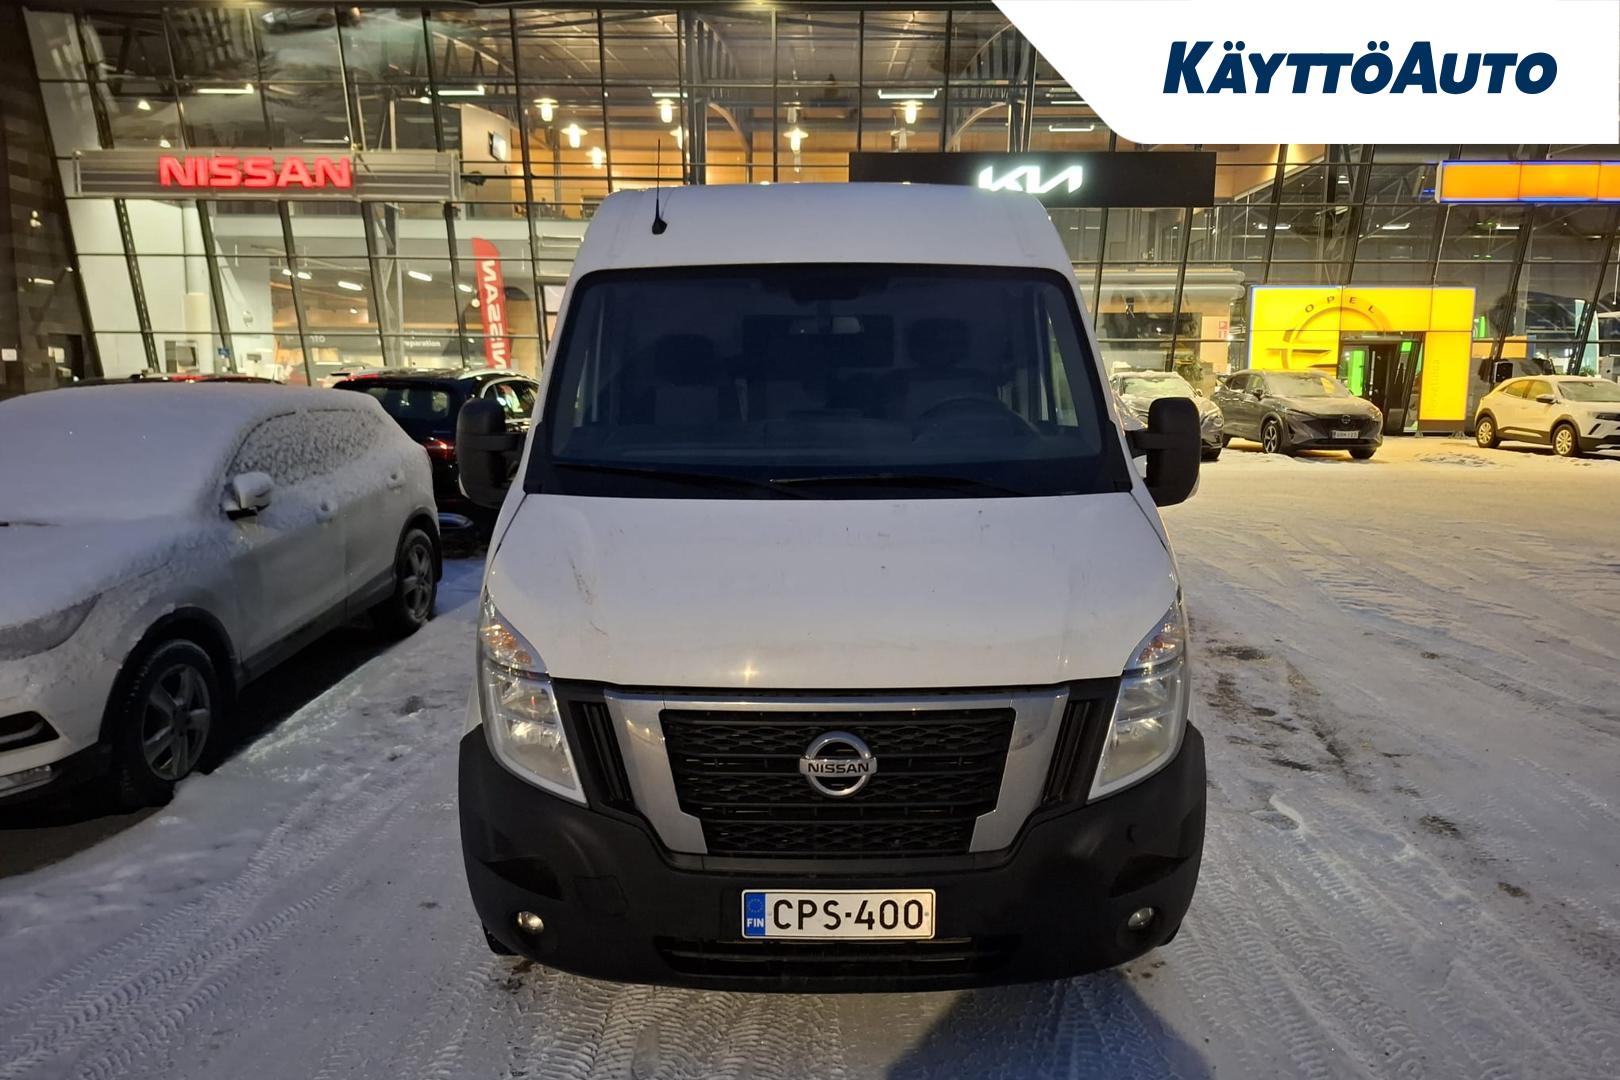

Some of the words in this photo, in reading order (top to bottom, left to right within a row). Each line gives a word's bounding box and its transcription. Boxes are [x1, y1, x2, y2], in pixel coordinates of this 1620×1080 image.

[159, 155, 351, 188] NISSAN
[978, 165, 1083, 194] KIA
[1304, 295, 1376, 314] OPEL
[807, 762, 869, 774] NISSAN
[746, 917, 765, 928] FIN
[773, 899, 924, 931] CPS-400
